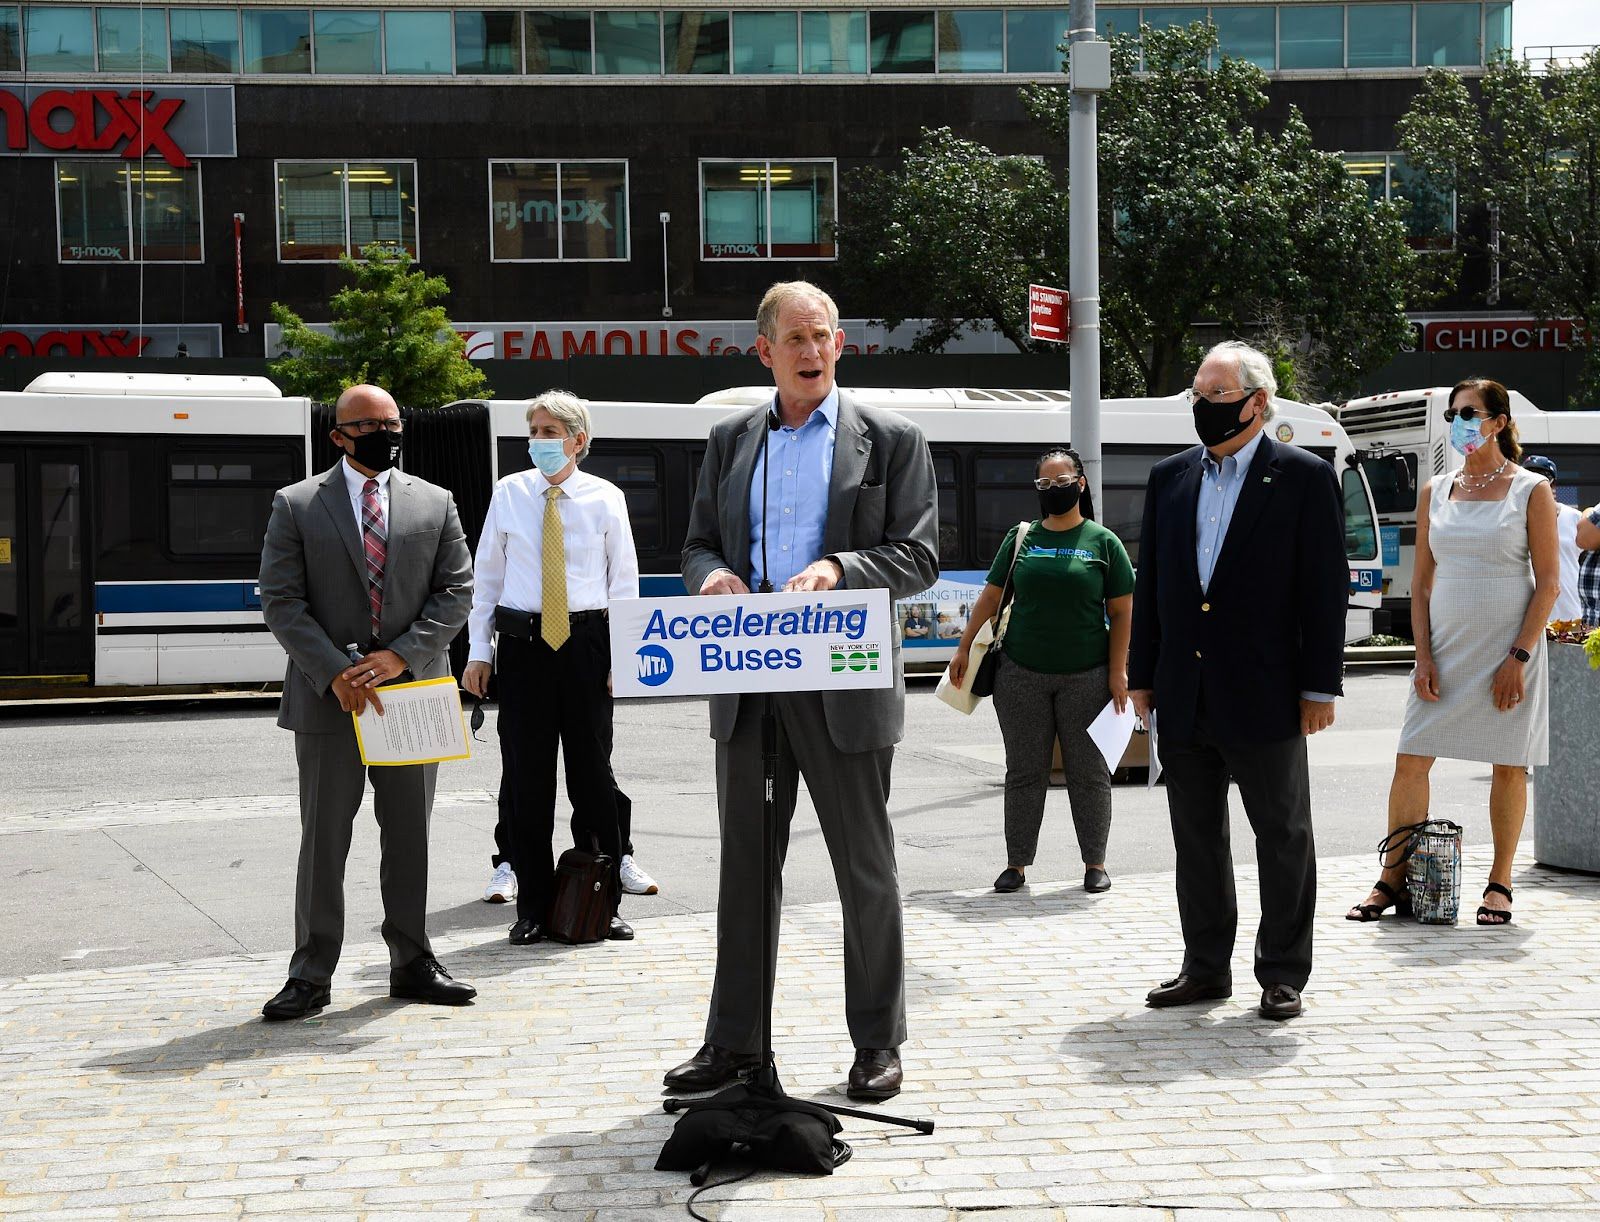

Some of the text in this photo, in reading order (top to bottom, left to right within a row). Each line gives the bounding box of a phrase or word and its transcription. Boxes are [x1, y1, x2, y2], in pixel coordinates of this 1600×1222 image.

[503, 330, 699, 360] FAMOUS
[1436, 328, 1585, 349] CHIPOTL
[1058, 549, 1093, 559] RIDERS
[952, 589, 975, 600] THE
[642, 603, 867, 640] Accelerating
[636, 653, 668, 679] MTA
[700, 643, 802, 673] Buses
[831, 651, 880, 673] DOT
